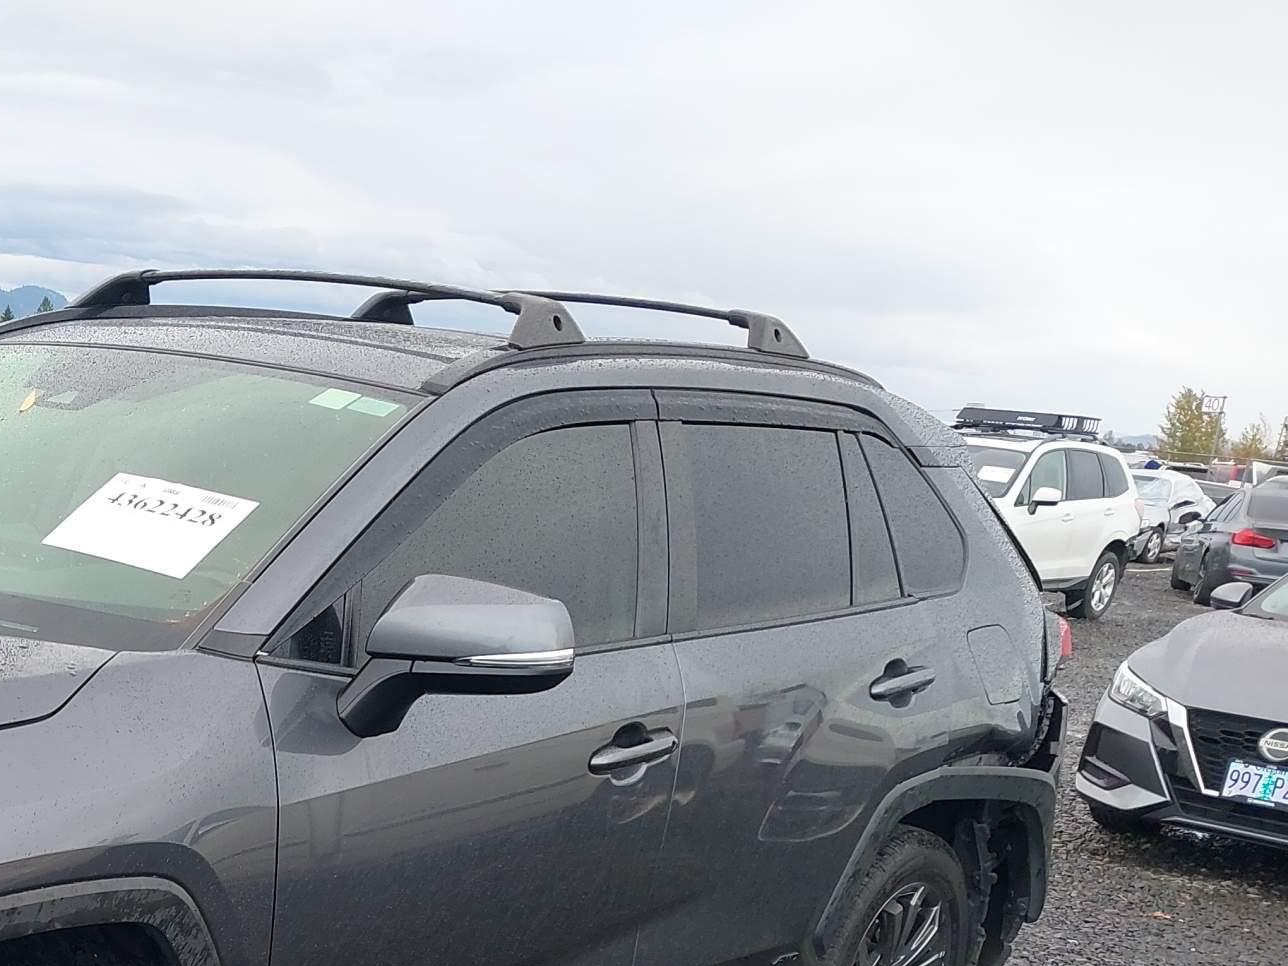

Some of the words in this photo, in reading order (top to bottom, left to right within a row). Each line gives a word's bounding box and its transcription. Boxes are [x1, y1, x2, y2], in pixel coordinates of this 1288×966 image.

[1204, 398, 1220, 411] 40
[106, 491, 223, 527] 43622428
[1228, 769, 1263, 793] 997
